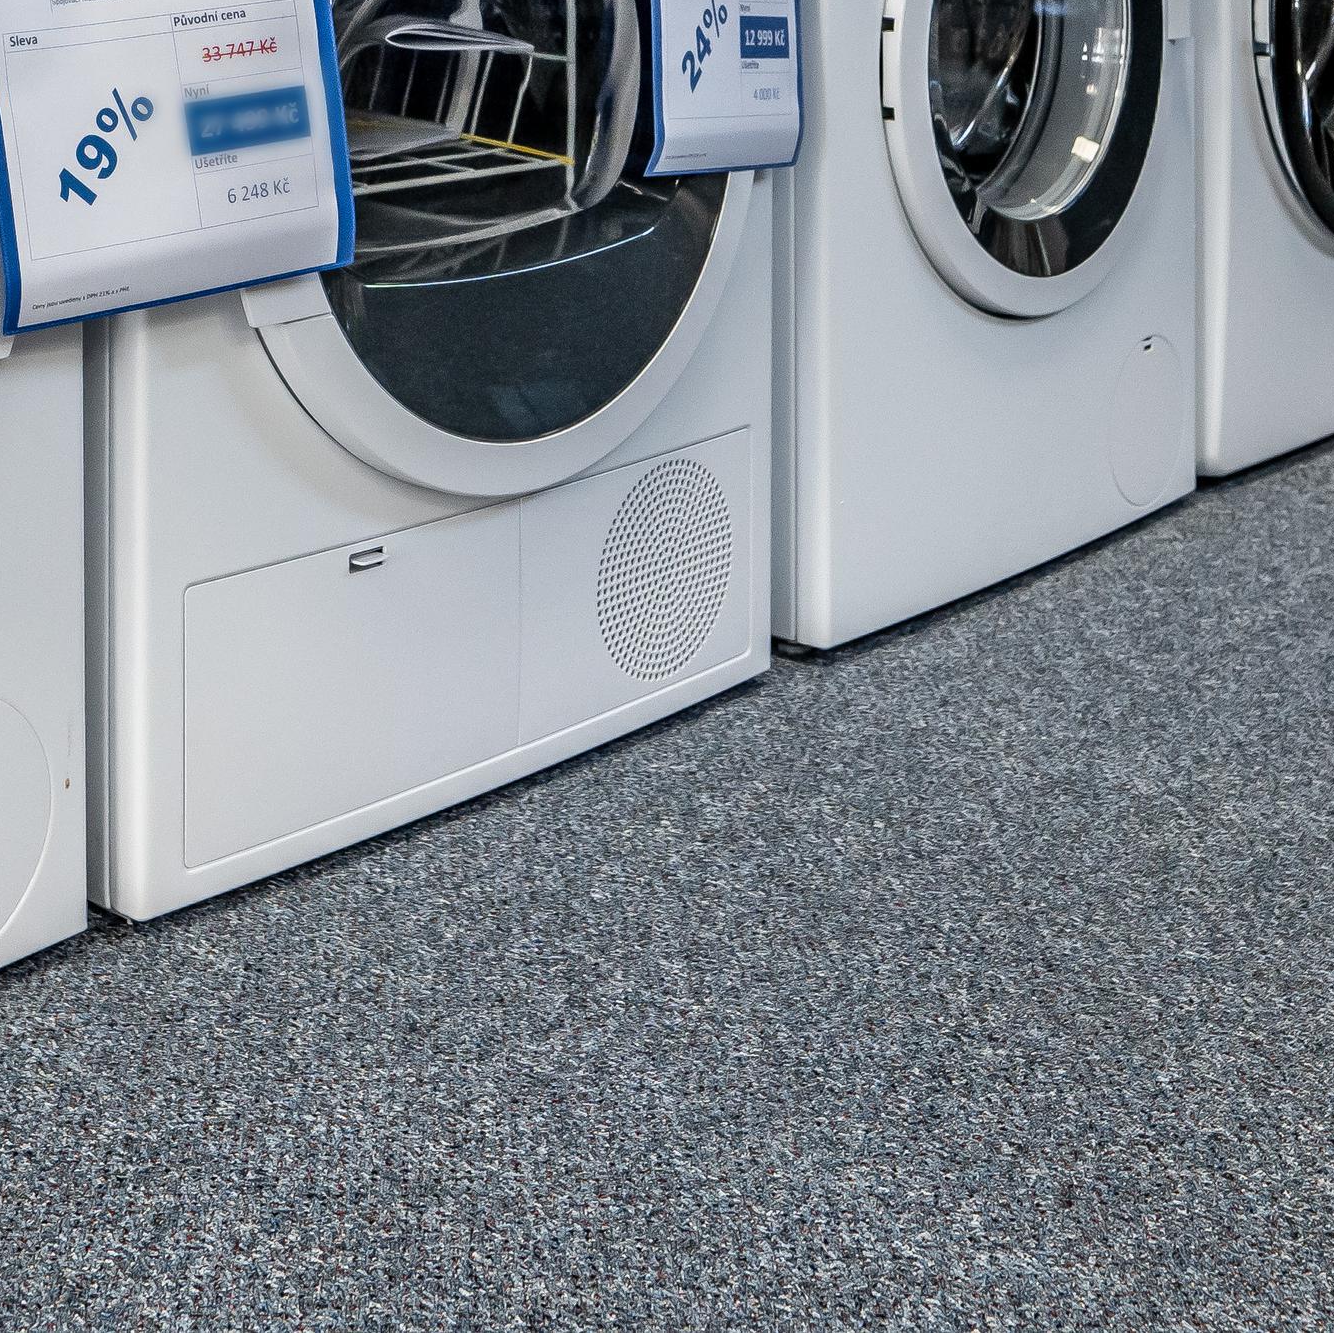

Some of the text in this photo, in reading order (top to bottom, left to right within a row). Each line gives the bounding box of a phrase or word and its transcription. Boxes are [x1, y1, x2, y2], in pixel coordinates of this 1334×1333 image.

[10, 8, 246, 47] Sleva Původní cena
[745, 29, 785, 46] 12 999 Kč
[202, 36, 277, 63] 33 747 Kč
[184, 84, 210, 99] Nyní
[58, 88, 154, 206] 19%
[194, 152, 238, 169] Ušetříte
[227, 177, 290, 204] 6 248 Kč
